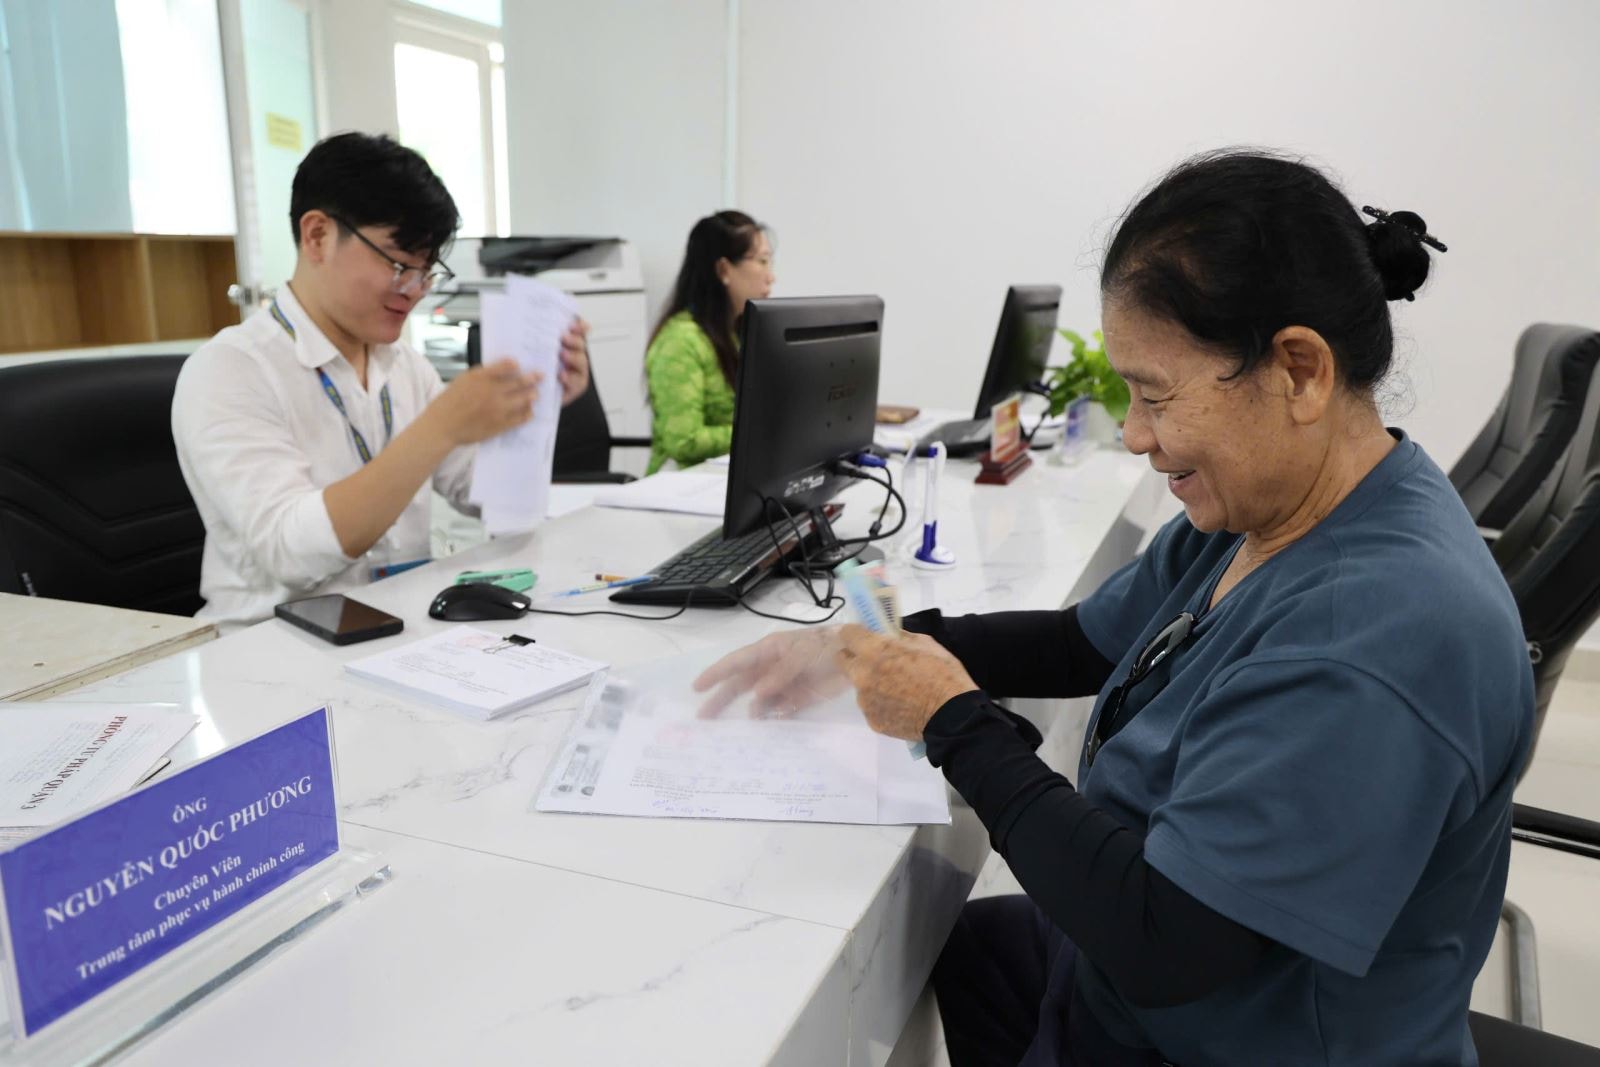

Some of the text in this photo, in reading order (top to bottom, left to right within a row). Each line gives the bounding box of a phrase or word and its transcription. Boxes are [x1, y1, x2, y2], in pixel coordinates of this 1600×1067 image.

[160, 821, 224, 869] QUỐC
[229, 776, 312, 832] PHƯƠNG
[172, 797, 207, 823] ÔNG
[76, 842, 305, 980] Trung tâm phục vụ hành chính công
[154, 855, 242, 910] Chuyên Viên
